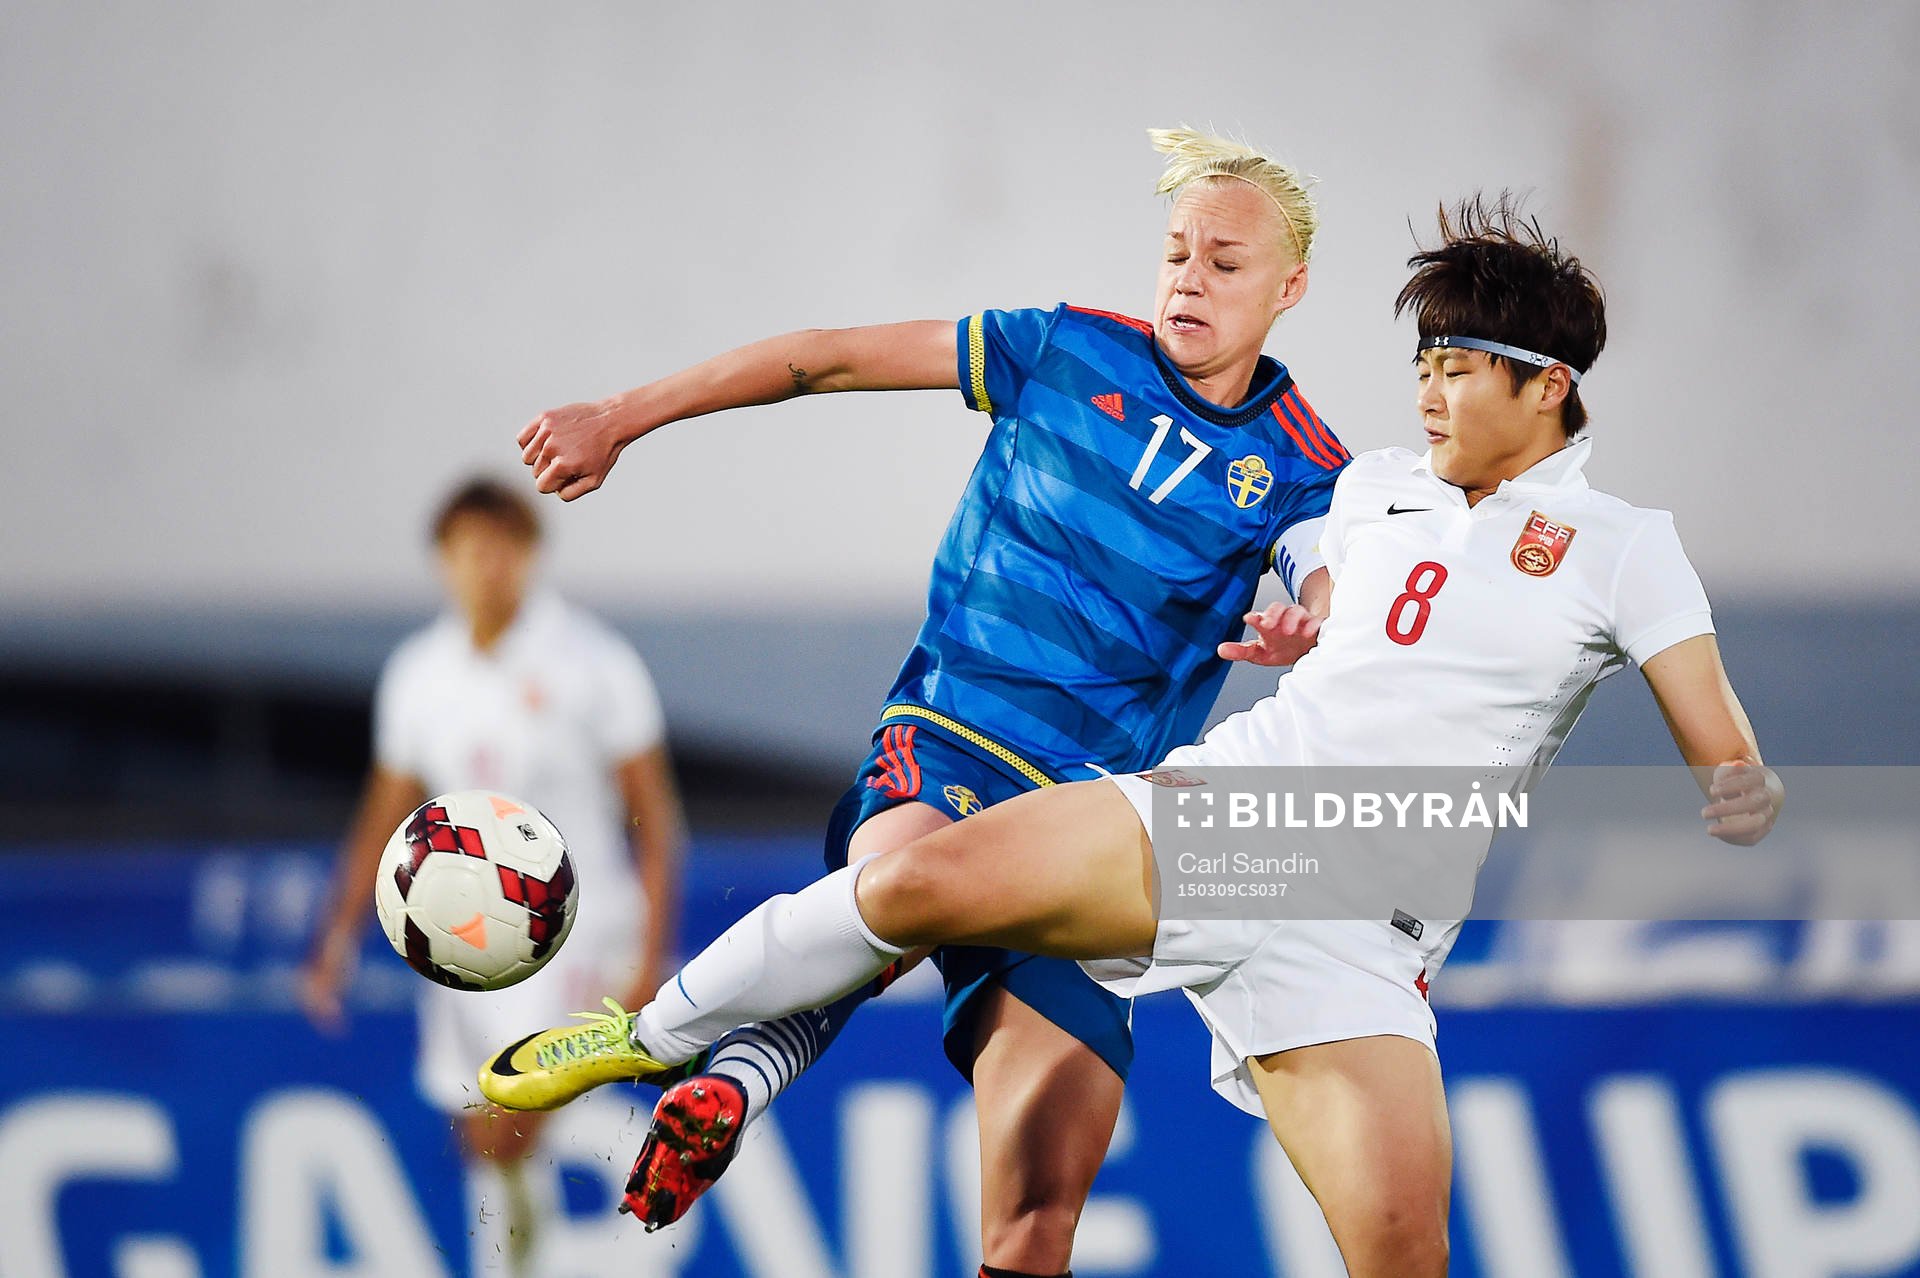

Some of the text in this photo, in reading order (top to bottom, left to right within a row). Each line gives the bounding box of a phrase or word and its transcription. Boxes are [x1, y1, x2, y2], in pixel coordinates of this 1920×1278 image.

[1129, 414, 1213, 505] 17
[1530, 515, 1572, 544] CFA
[1385, 560, 1448, 646] 8
